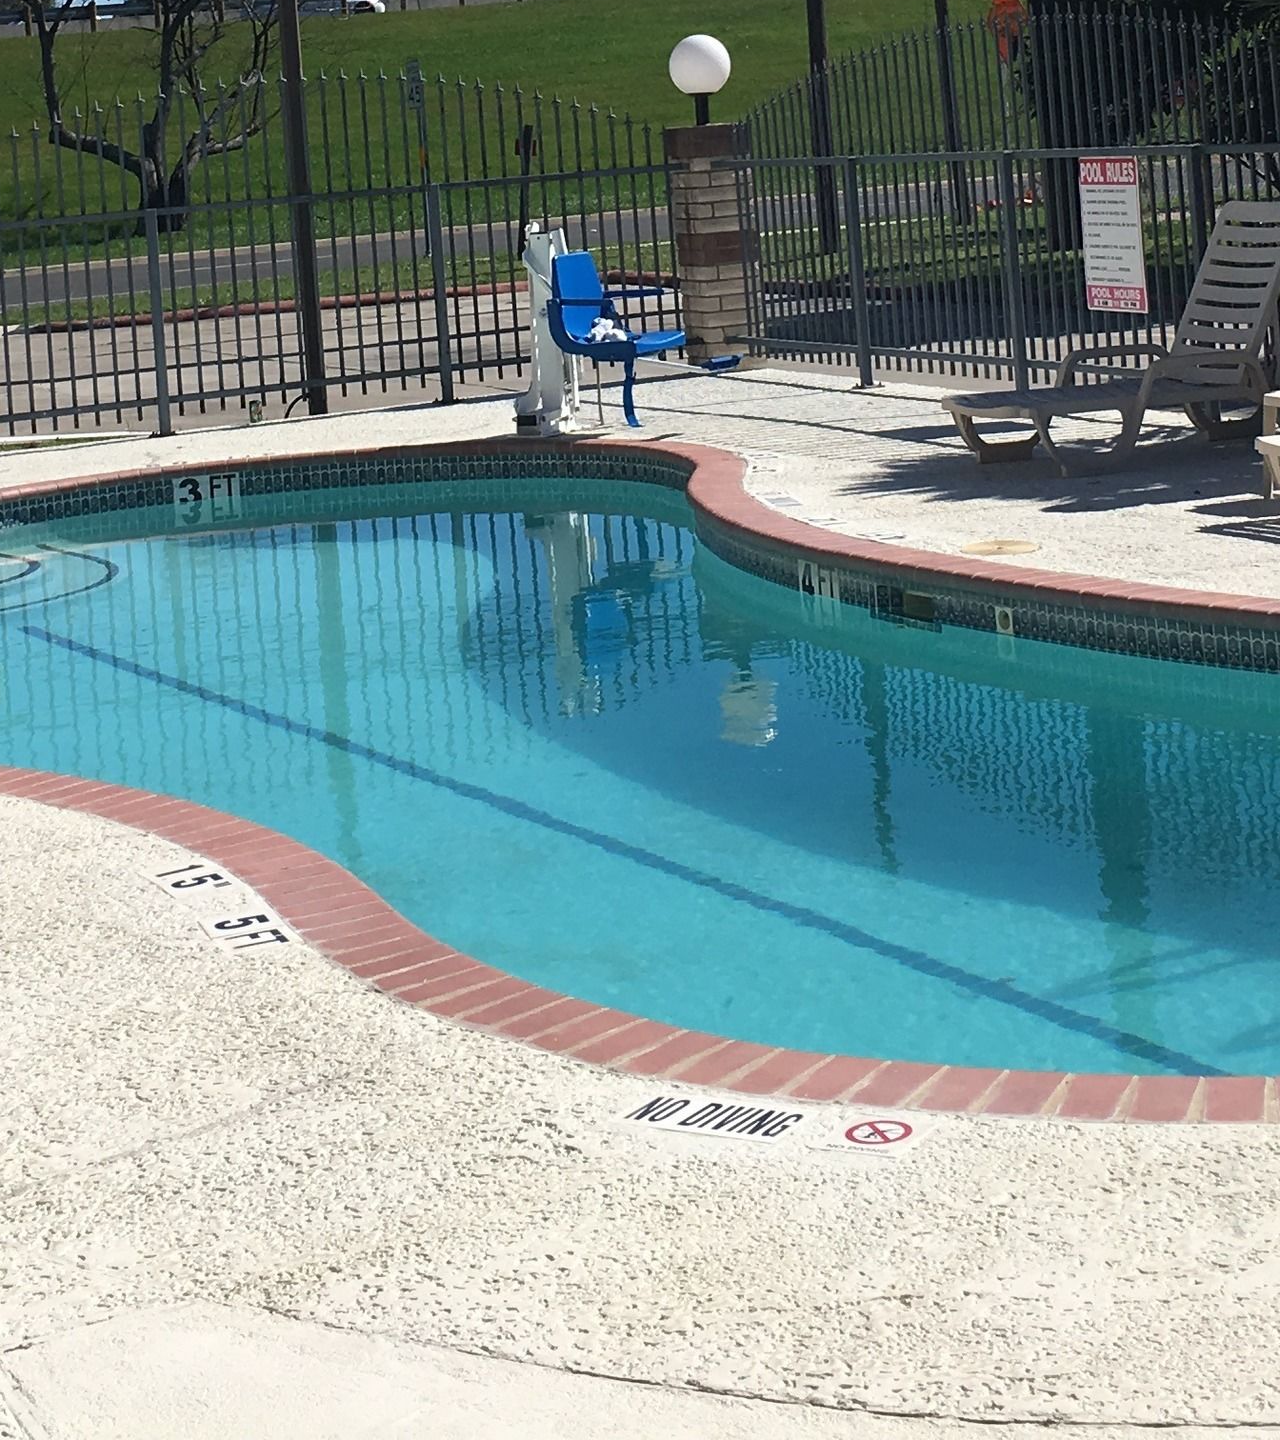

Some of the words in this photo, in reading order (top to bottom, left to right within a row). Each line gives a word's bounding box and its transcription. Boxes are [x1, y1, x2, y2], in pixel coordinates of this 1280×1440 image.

[1080, 162, 1104, 182] POOL
[1106, 162, 1134, 183] RULES
[1091, 287, 1112, 299] POOL
[1114, 288, 1141, 300] HOURS
[179, 478, 202, 502] 3
[209, 474, 236, 498] FT
[224, 928, 290, 949] FT
[624, 1096, 691, 1122] NO
[677, 1102, 804, 1137] DIVING
